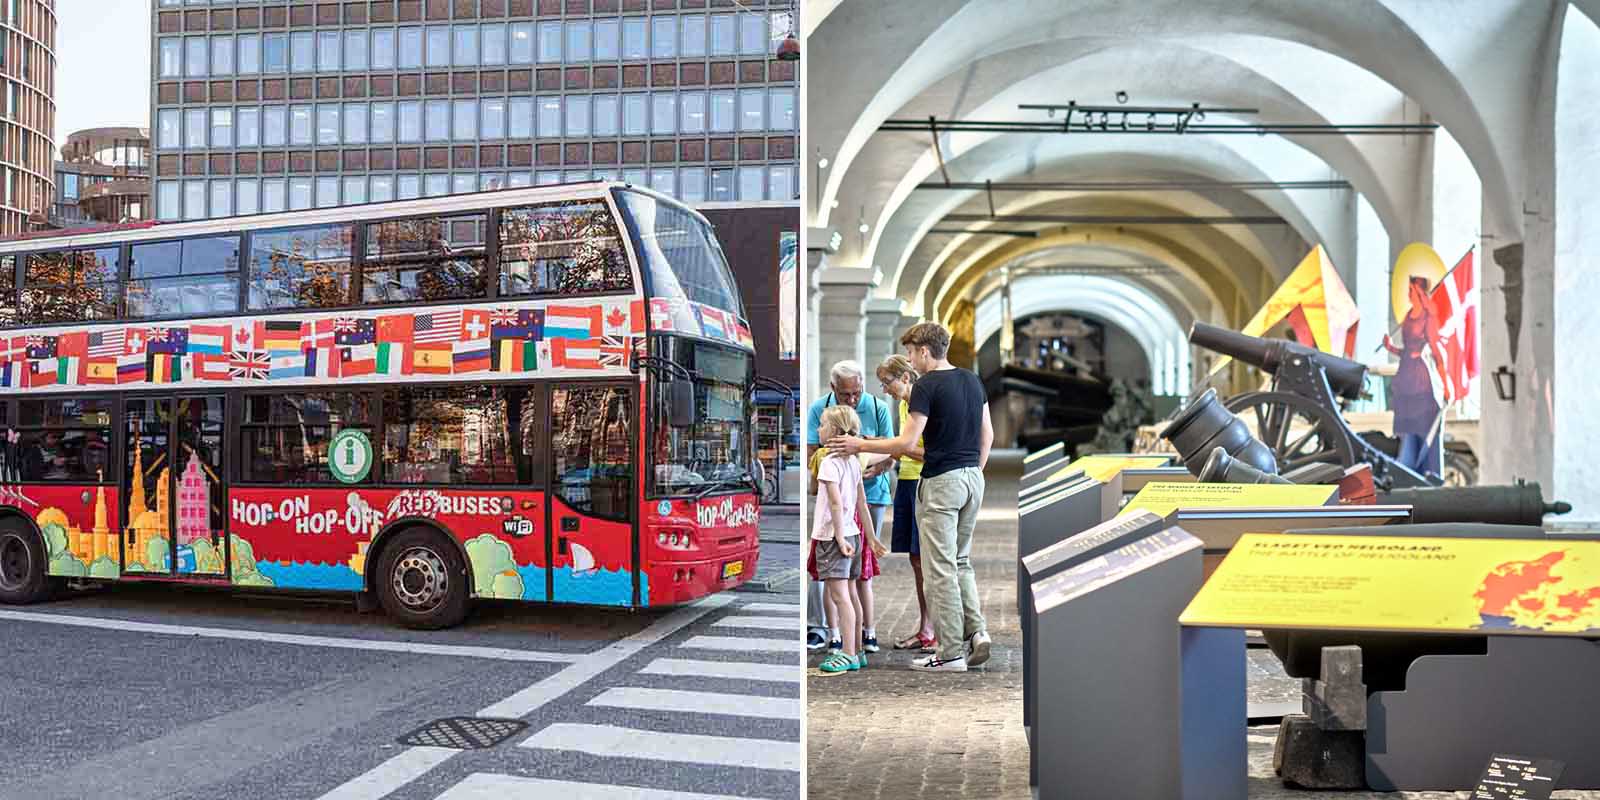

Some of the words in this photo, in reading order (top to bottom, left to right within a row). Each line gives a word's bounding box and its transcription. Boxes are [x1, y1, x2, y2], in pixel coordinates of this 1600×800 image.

[232, 494, 310, 526] HOP-ON
[295, 505, 385, 535] HOP-OFF
[399, 495, 435, 513] RED
[440, 496, 502, 515] BUSES
[696, 495, 734, 528] HOP-ON
